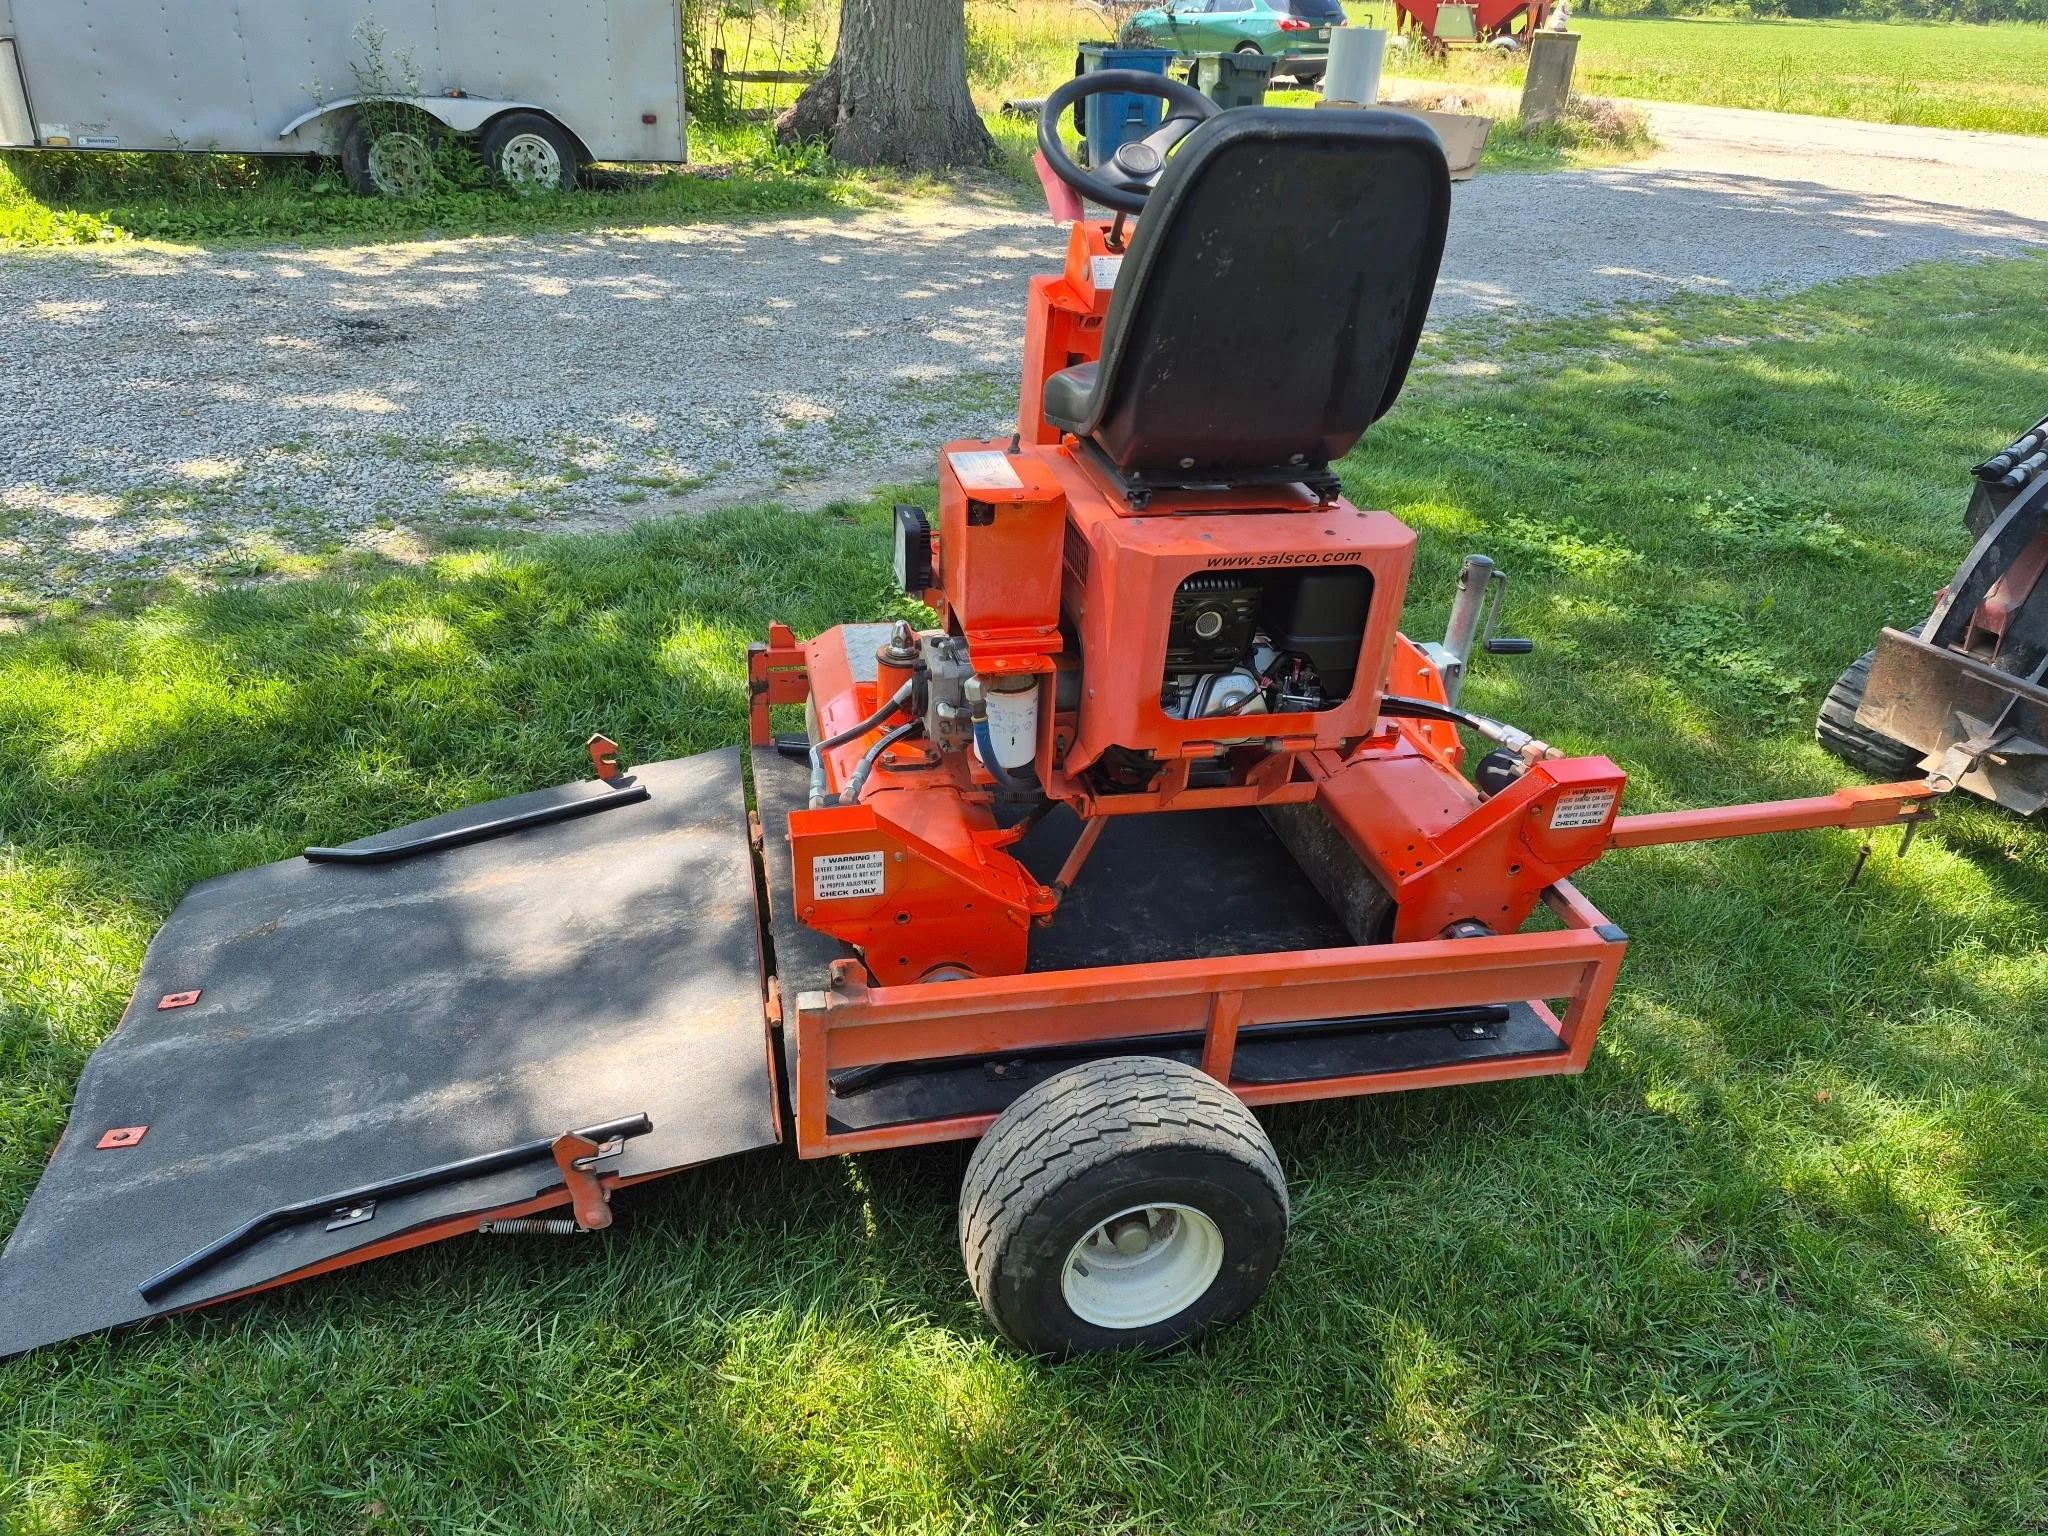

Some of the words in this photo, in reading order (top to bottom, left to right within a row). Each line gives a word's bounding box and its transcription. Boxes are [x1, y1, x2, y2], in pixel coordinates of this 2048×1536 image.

[1207, 551, 1362, 568] www.salsco.com
[828, 854, 870, 864] WARNING
[845, 879, 877, 887] ADJUSTMENT
[819, 889, 849, 898] CHECK
[852, 887, 877, 895] DAILY
